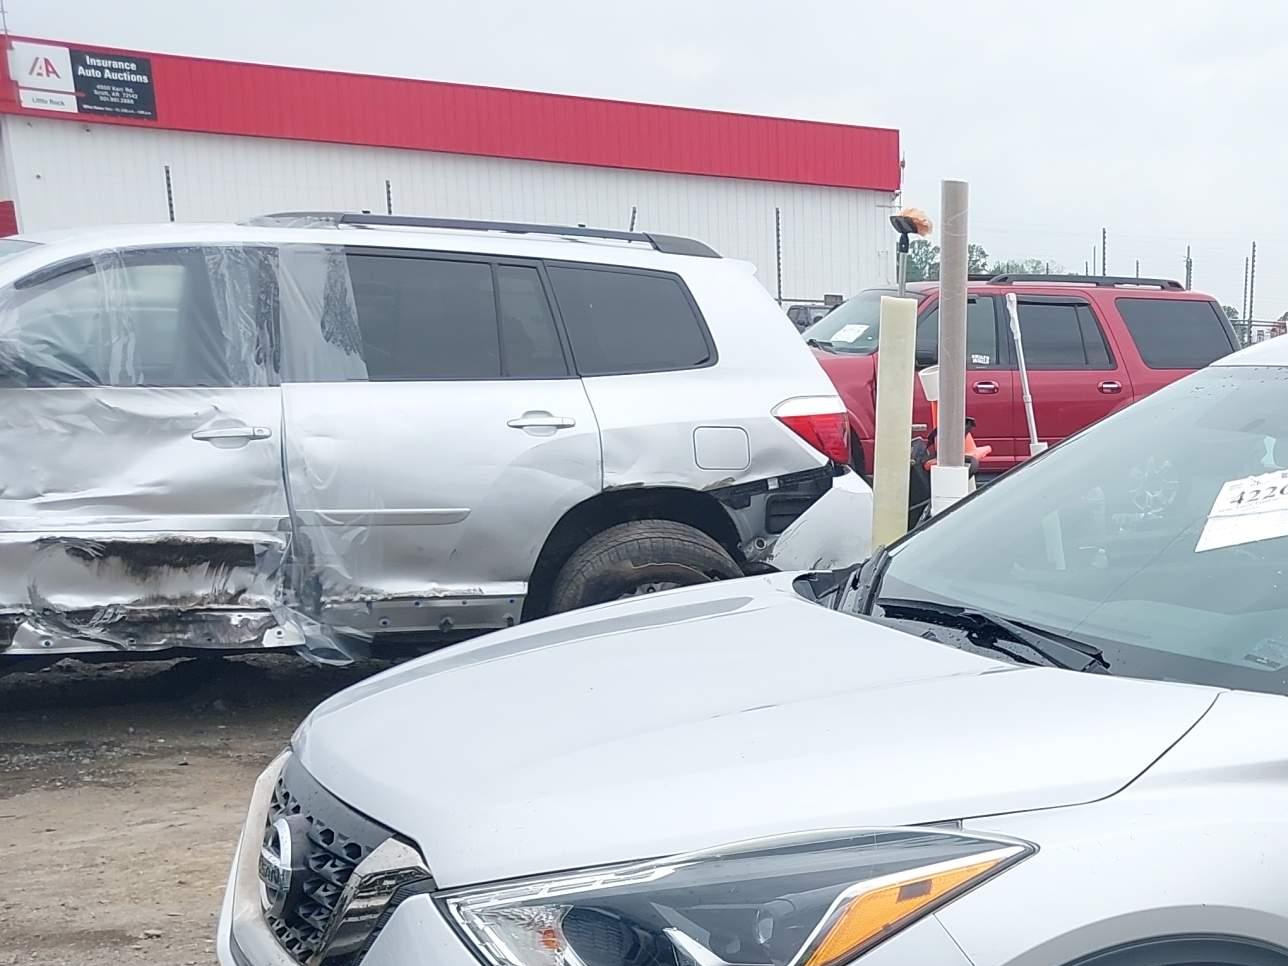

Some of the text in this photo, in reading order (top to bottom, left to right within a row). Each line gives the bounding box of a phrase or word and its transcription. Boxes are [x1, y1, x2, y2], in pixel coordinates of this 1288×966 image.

[85, 55, 137, 72] Insurance
[78, 66, 149, 84] Auto Auctions
